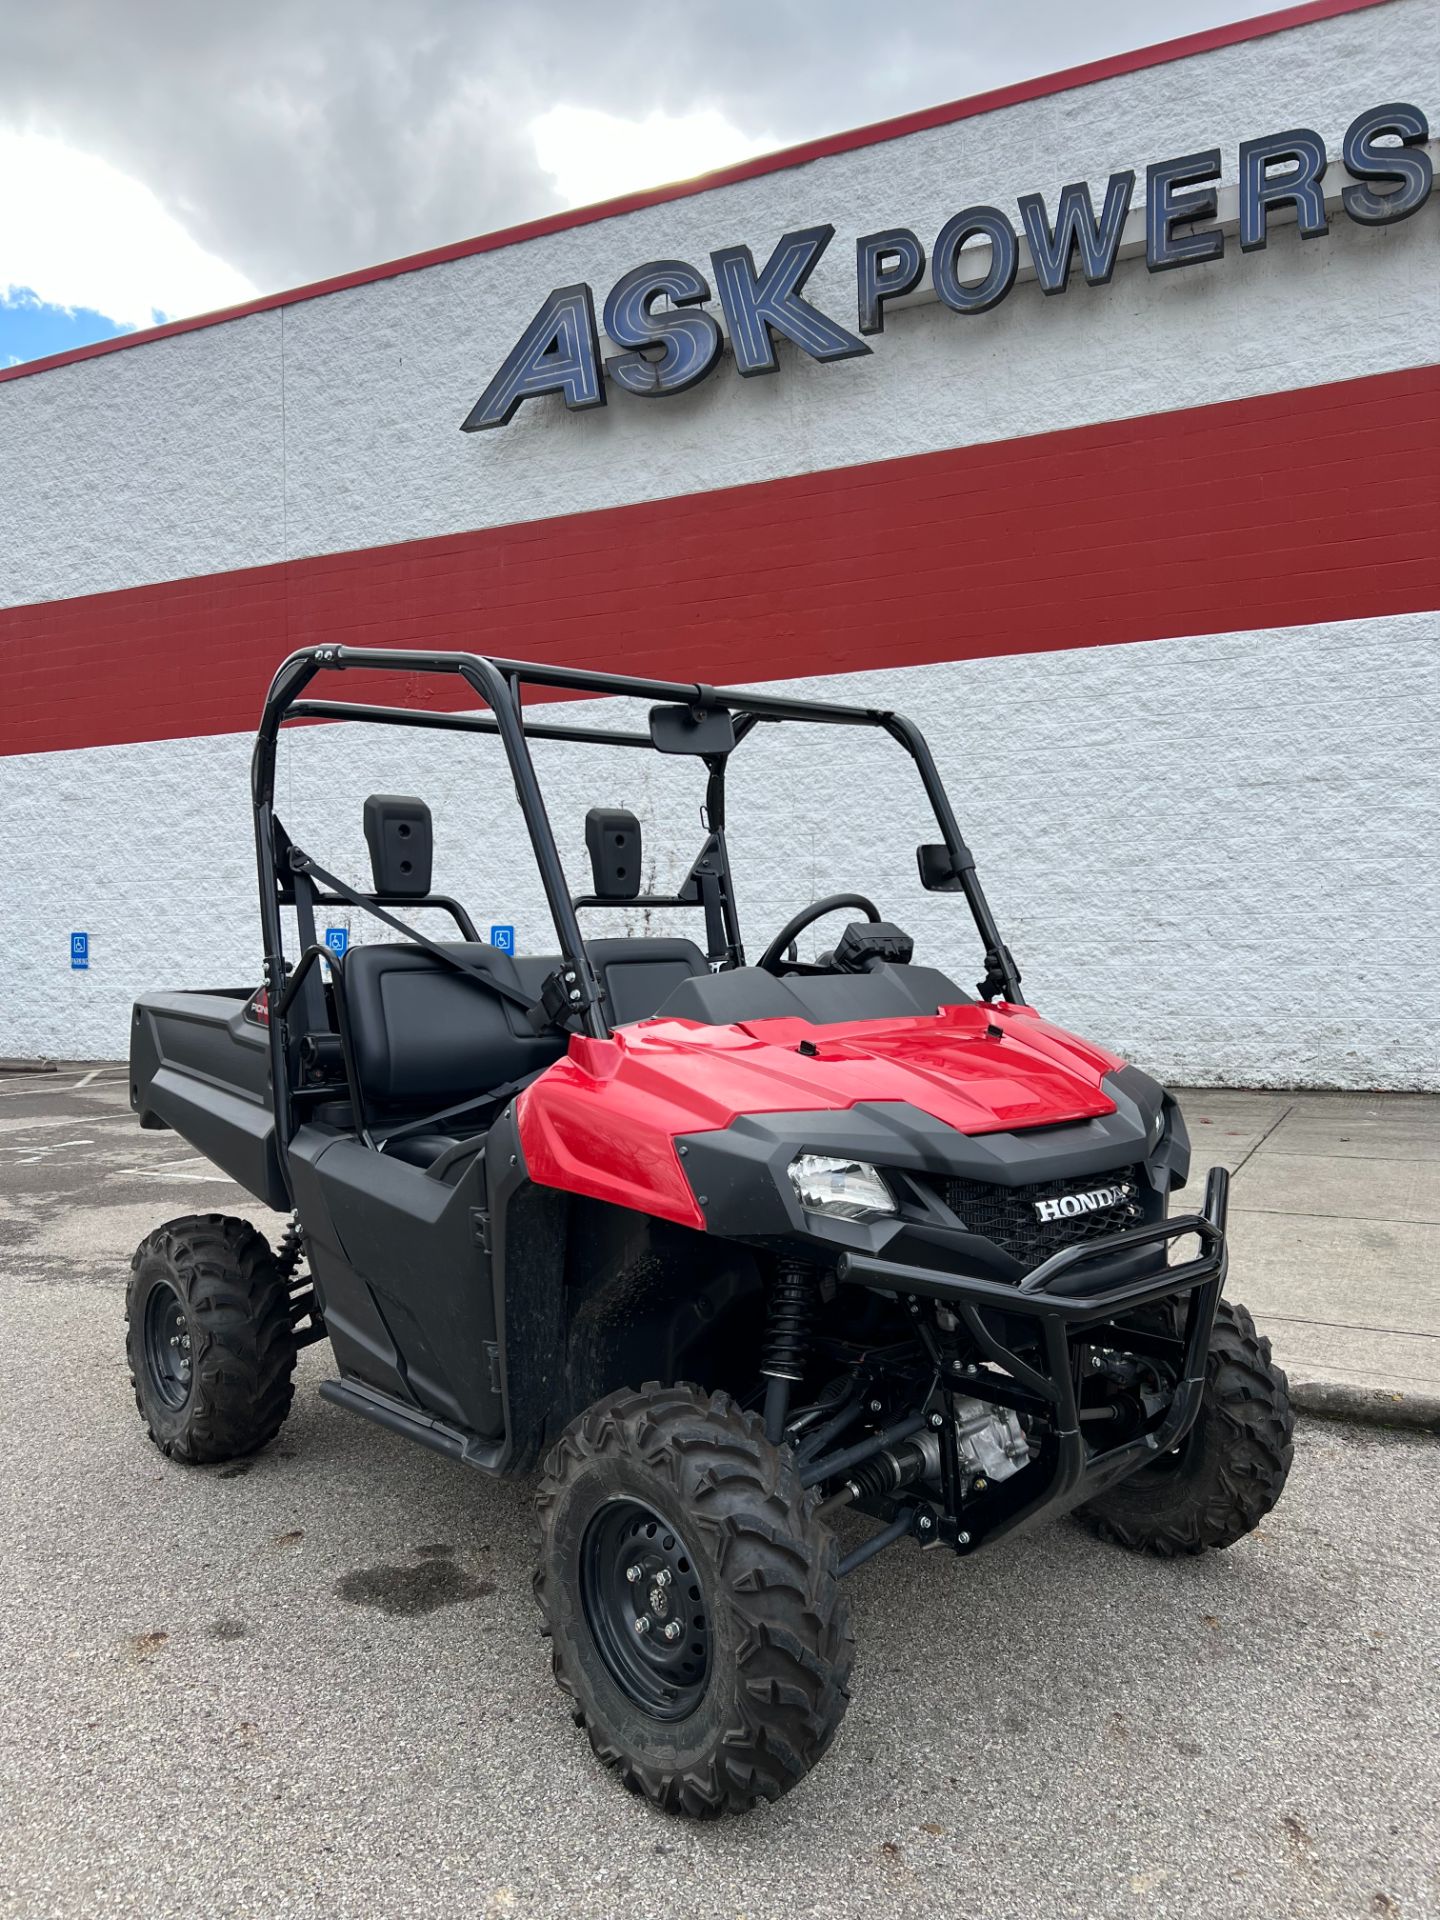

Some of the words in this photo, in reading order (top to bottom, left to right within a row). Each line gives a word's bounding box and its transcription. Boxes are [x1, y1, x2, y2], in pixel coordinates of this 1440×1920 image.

[460, 223, 873, 432] ASK
[857, 103, 1433, 335] POWERS
[1035, 1185, 1126, 1222] HONDA
